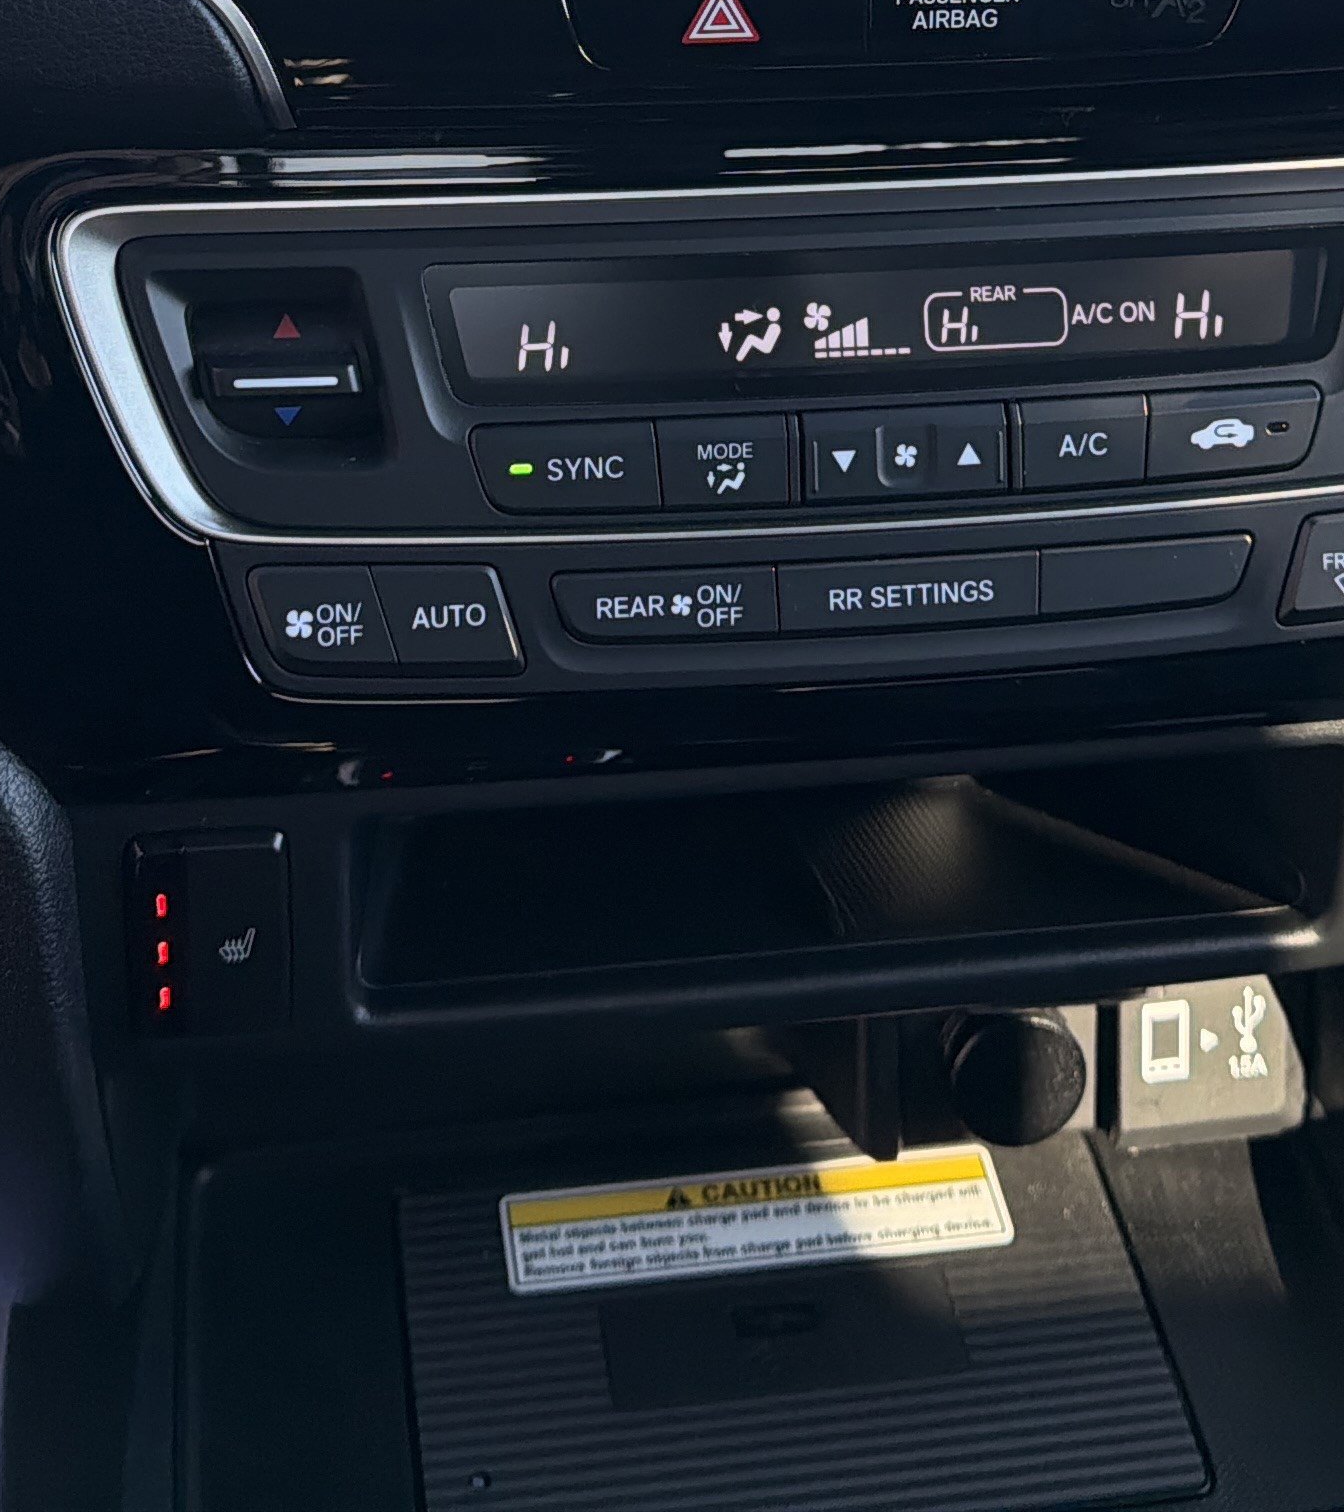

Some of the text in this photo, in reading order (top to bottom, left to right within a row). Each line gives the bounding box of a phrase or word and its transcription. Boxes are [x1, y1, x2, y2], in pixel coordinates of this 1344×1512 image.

[911, 8, 999, 30] AIRBAG
[969, 284, 1017, 303] REAR
[1072, 298, 1156, 325] A/C ON
[696, 441, 754, 461] MODE
[1058, 431, 1108, 459] A/C
[546, 454, 625, 482] SYNC
[595, 583, 742, 620] REAR ON/
[828, 579, 995, 612] RR SETTINGS
[316, 601, 363, 625] ON/
[411, 603, 487, 630] AUTO
[697, 605, 744, 629] OFF
[317, 624, 364, 647] OFF
[702, 1175, 821, 1202] CAUTION
